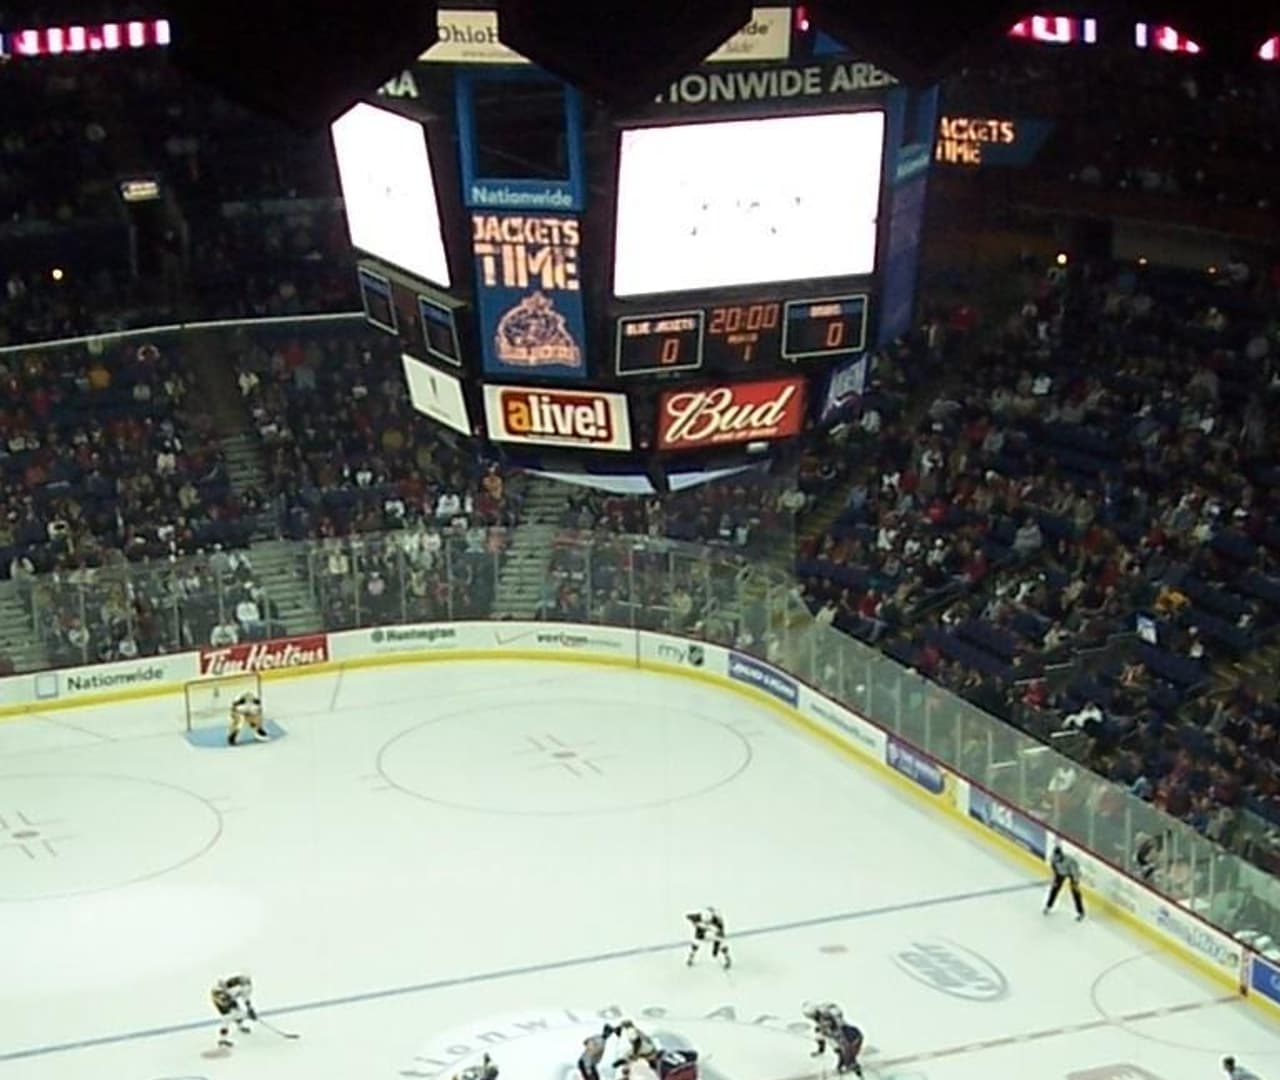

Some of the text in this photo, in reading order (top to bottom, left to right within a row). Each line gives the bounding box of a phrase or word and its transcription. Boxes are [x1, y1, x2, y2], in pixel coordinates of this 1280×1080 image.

[655, 67, 822, 103] IONWIDE
[472, 185, 573, 207] Nationwide
[472, 215, 581, 246] JACKETS
[473, 243, 581, 291] TIME
[709, 302, 780, 334] 20:00
[826, 322, 844, 347] 0
[661, 338, 680, 364] 0
[508, 393, 609, 438] alive!
[664, 384, 796, 443] Bud
[203, 643, 326, 676] Tim Hortons
[66, 666, 164, 692] Nationwide
